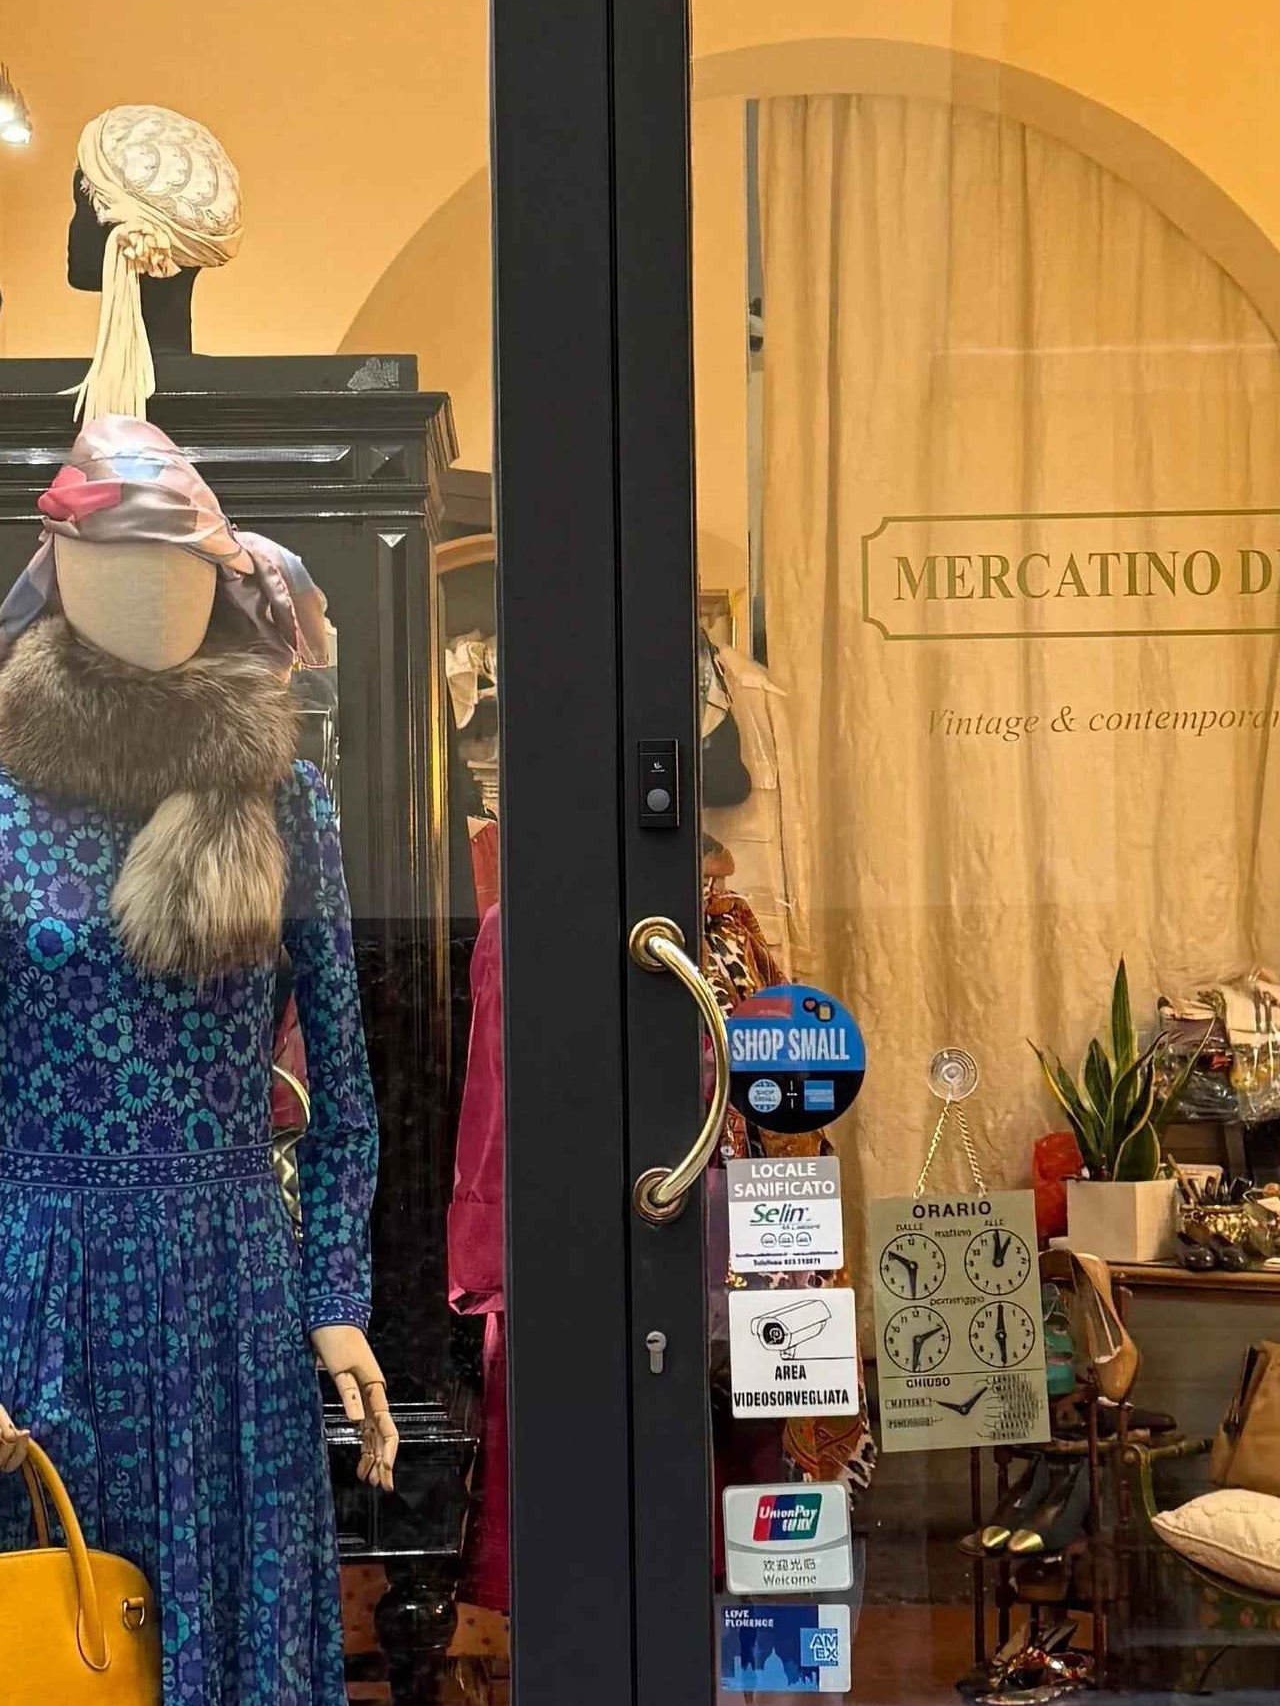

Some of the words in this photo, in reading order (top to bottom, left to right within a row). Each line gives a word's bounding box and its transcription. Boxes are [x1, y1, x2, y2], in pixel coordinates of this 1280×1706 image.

[893, 549, 1221, 601] MERCATINO
[927, 708, 1039, 743] Vintage
[1050, 705, 1076, 734] &
[731, 1028, 784, 1062] SHOP
[788, 1027, 851, 1061] SMALL
[751, 1162, 817, 1179] LOCALE
[734, 1180, 836, 1198] SANIFICATO
[912, 1200, 992, 1219] ORARIO
[775, 1364, 807, 1381] AREA
[733, 1389, 850, 1408] VIDEOSORVEGLIATA
[758, 1504, 818, 1525] UnionPay
[763, 1574, 817, 1586] Welcome
[725, 1609, 750, 1619] LOVE
[725, 1618, 775, 1628] FLORENCE
